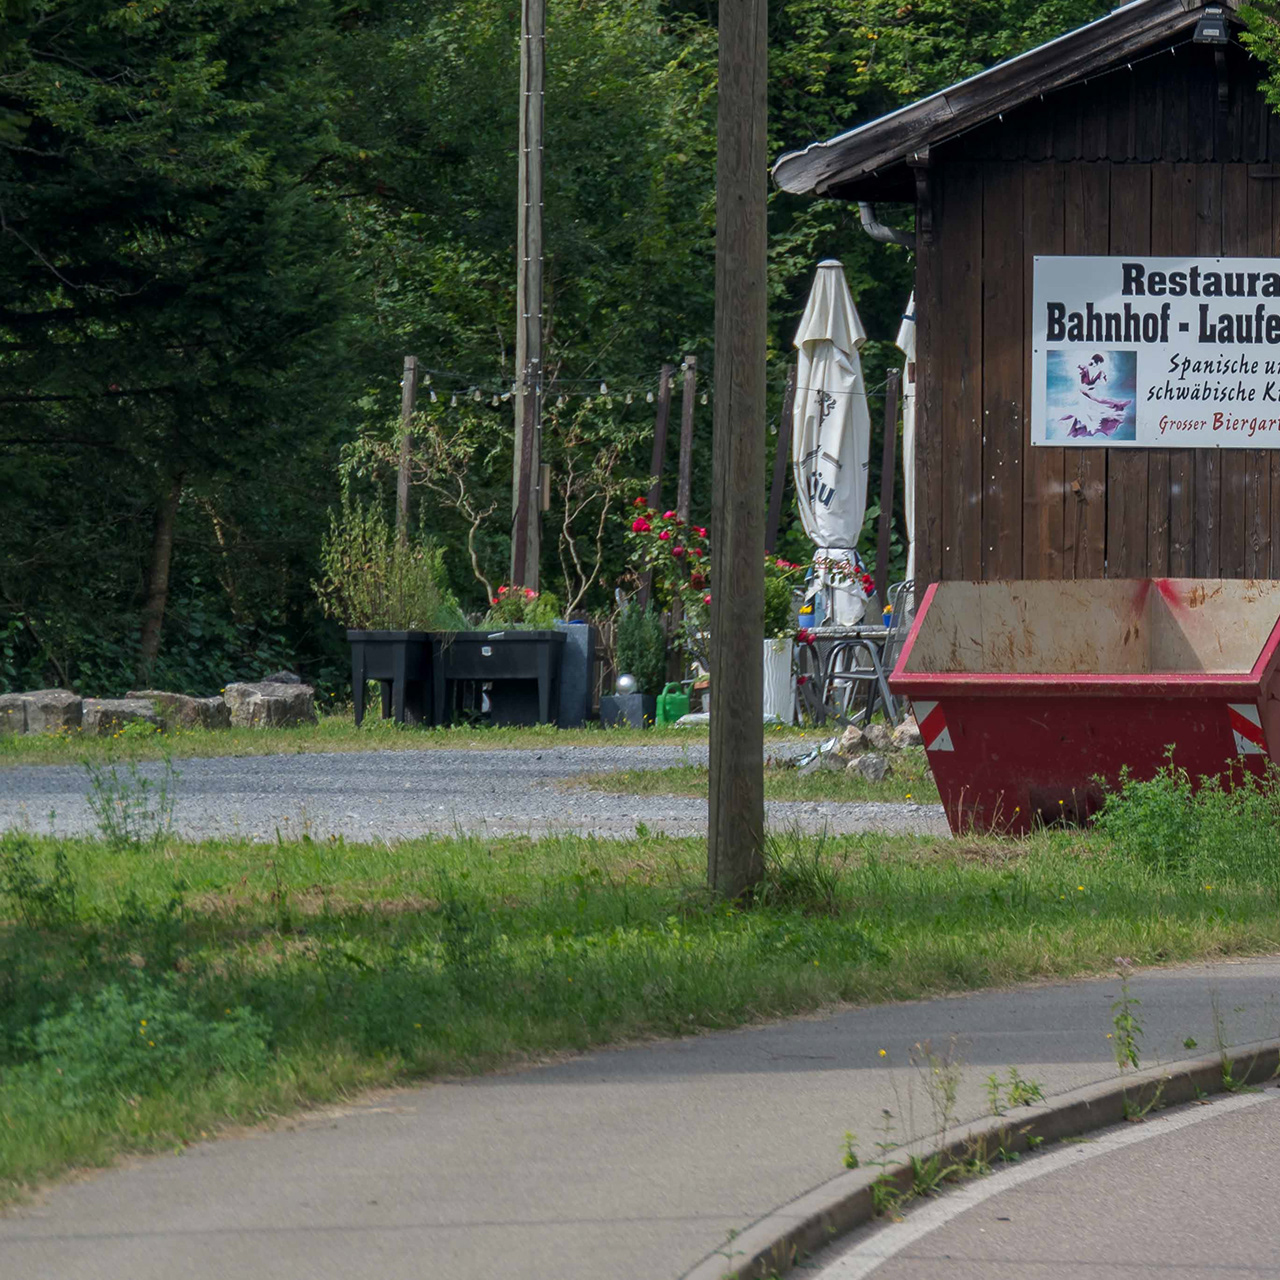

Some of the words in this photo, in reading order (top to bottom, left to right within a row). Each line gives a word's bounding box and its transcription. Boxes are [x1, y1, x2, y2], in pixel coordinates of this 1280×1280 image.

[1046, 302, 1170, 343] Bahnhof
[1168, 353, 1258, 381] Spanische
[1147, 380, 1256, 403] schwäbische
[1159, 414, 1207, 433] Grosser
